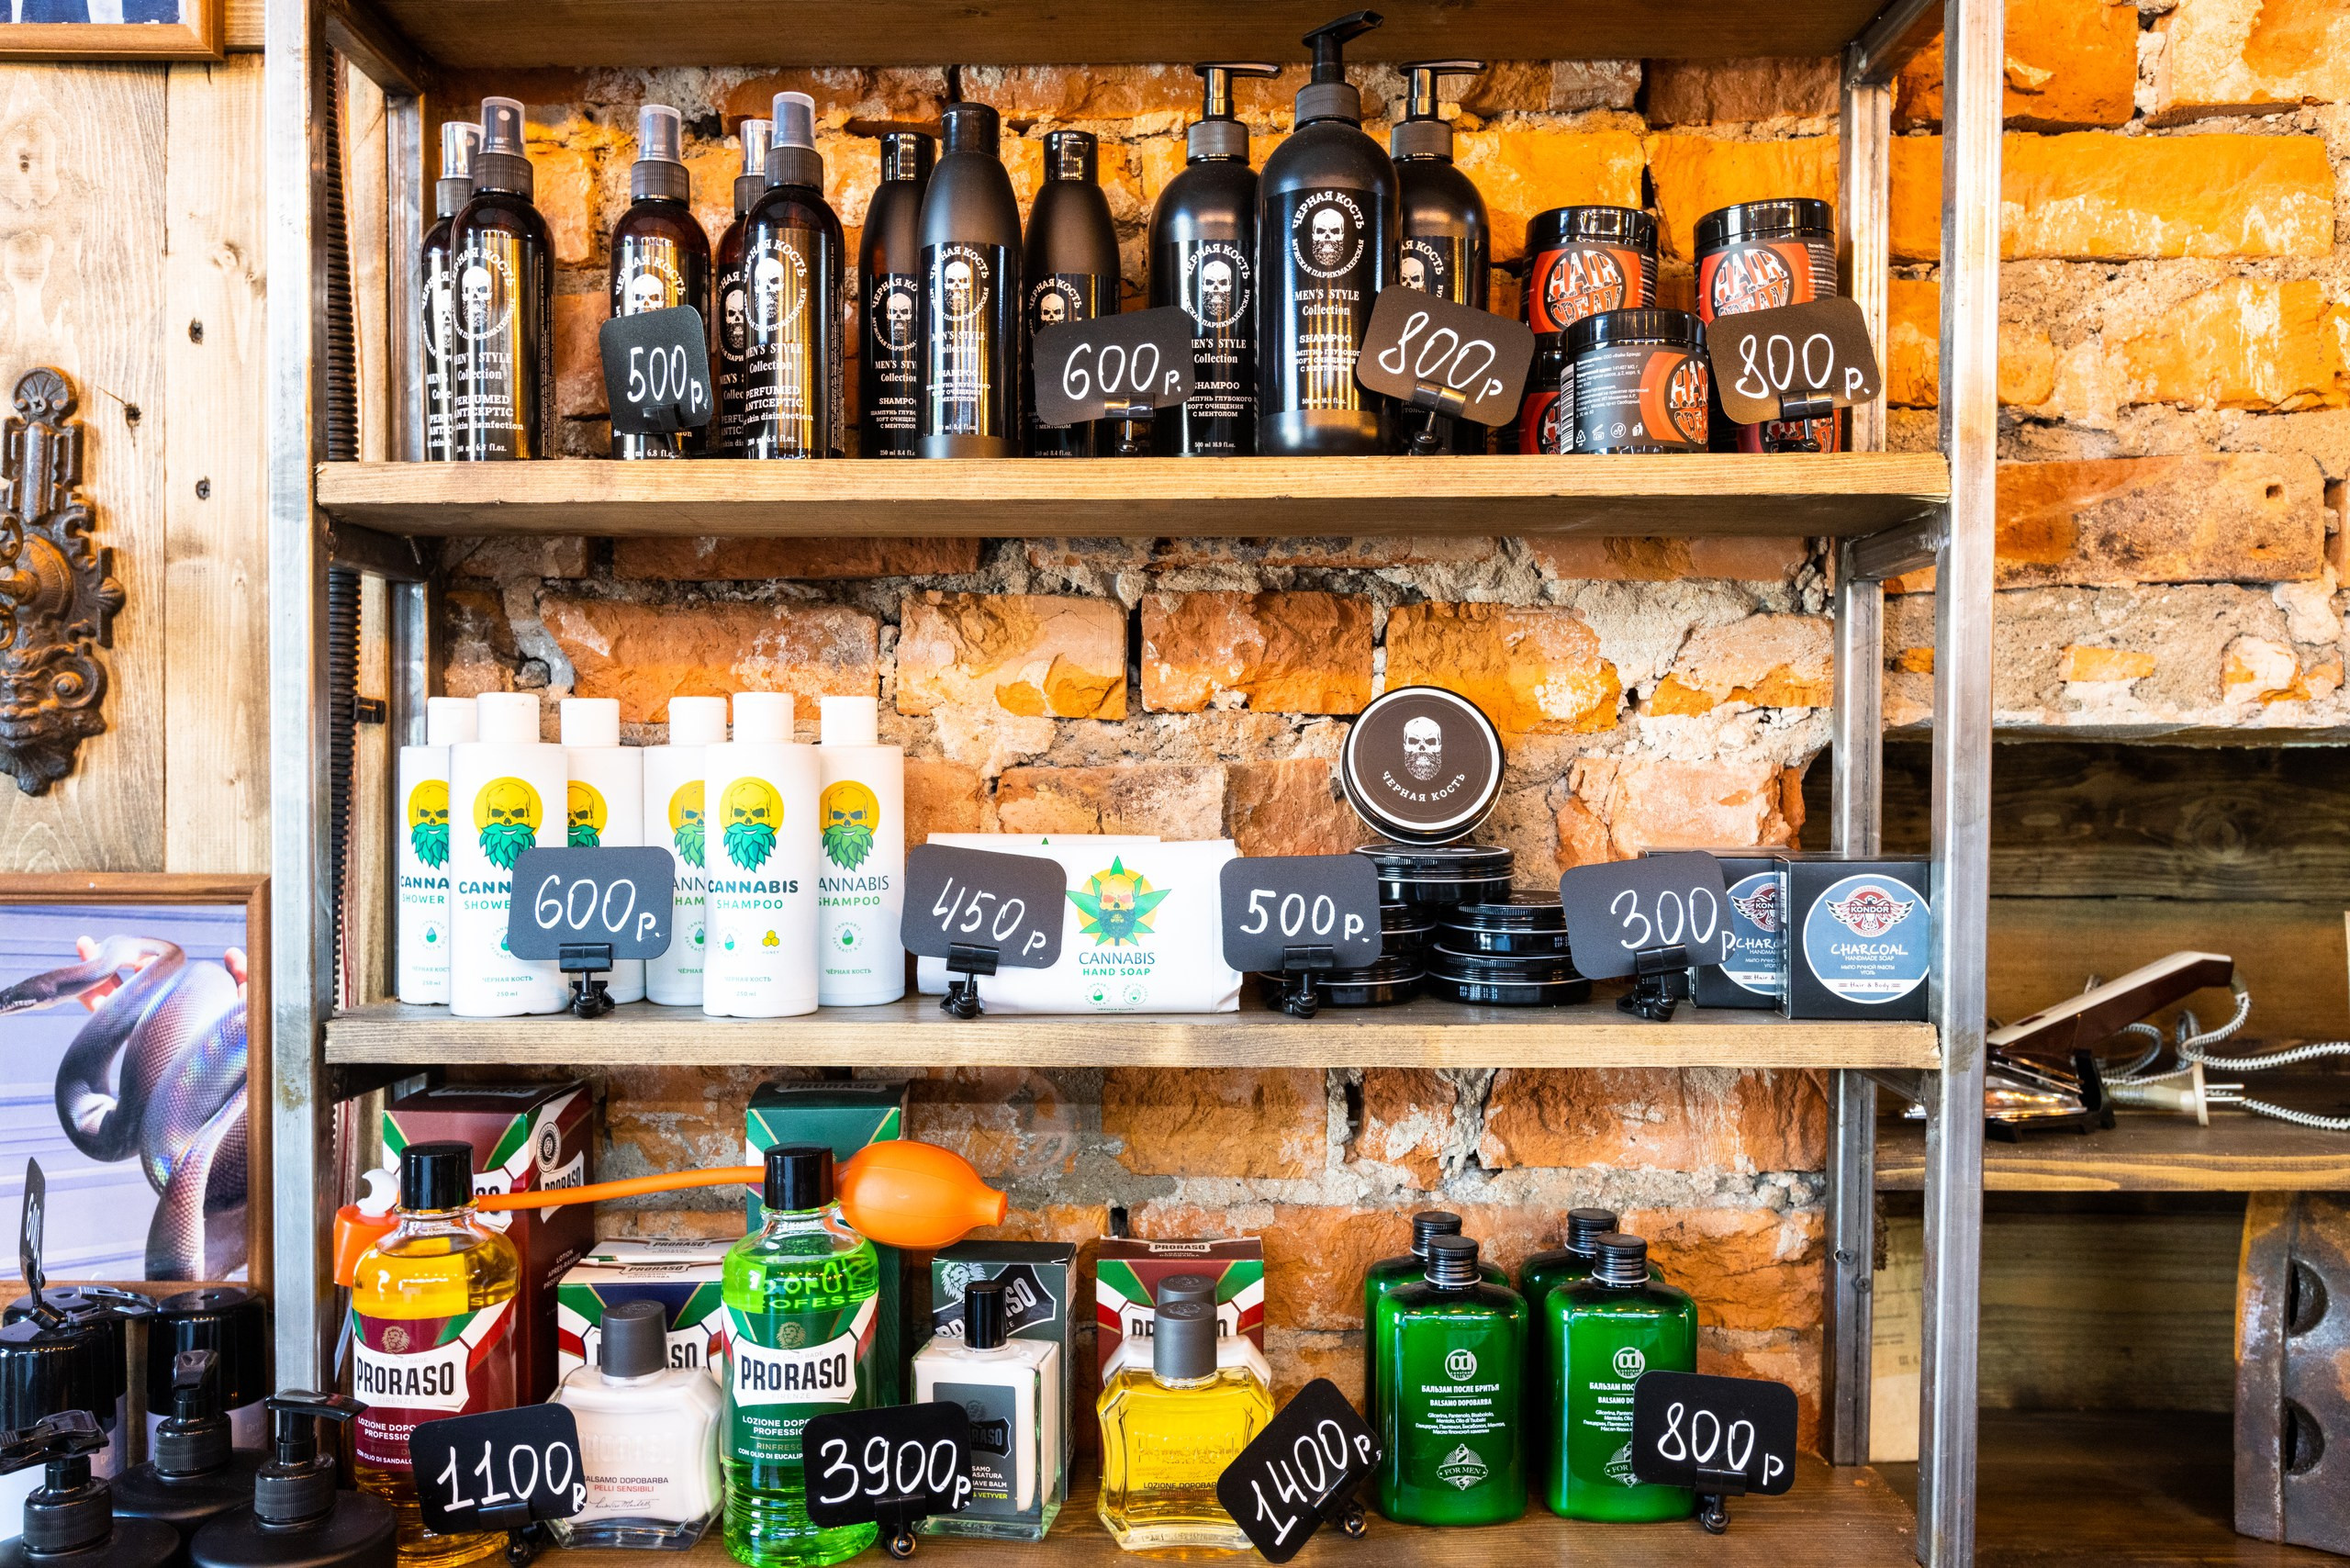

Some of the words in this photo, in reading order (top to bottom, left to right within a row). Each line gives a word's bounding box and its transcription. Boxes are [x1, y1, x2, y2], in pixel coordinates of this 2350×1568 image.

[1292, 191, 1334, 230] ЧЕРНАЯ
[1335, 192, 1365, 230] КОСТЬ
[774, 239, 808, 277] КОСТЬ
[963, 247, 990, 279] КОСТЬ
[1187, 243, 1221, 276] ЕРНАЯ
[1223, 244, 1251, 279] КОСТЬ
[1311, 239, 1365, 278] ПАРИКМАХЕРСКАЯ
[1416, 241, 1444, 275] КОСТЬ
[480, 248, 516, 287] КОСТЬ
[654, 257, 687, 296] КОСТЬ
[1547, 250, 1622, 303] HAIR
[1714, 248, 1789, 308] HAIR
[872, 277, 902, 308] ЧЕРНАЯ
[1028, 278, 1055, 310] ЧЕРНАЯ
[1056, 279, 1082, 308] КОСТЬ
[1329, 288, 1360, 301] STYLE
[1302, 304, 1350, 316] Collection
[1218, 338, 1247, 349] STYLE
[1299, 333, 1352, 343] SHAMPOO
[770, 342, 803, 354] STYLE
[478, 352, 513, 364] STYLE
[875, 359, 897, 370] MEN'S
[1194, 353, 1238, 364] Collection
[749, 360, 792, 374] Collection
[458, 368, 502, 381] Colection
[745, 386, 800, 400] PERFUMED
[454, 395, 509, 406] PERUMED
[744, 398, 804, 412] ANTICEPTIC
[760, 411, 813, 421] disinfection
[472, 420, 524, 431] isinfection
[1382, 770, 1427, 802] ЧЕРНАЯ
[1431, 771, 1466, 801] КОСТЬ
[401, 875, 449, 890] CANNA
[459, 880, 511, 894] CANN
[708, 879, 799, 894] CANNABIS
[402, 894, 445, 904] SHOWER
[717, 899, 783, 909] SHAMPOO
[534, 874, 661, 943] 600р.
[1239, 889, 1371, 943] 500р.
[1610, 887, 1737, 961] 300р.
[1830, 943, 1908, 956] CHARCOAL
[1079, 952, 1156, 965] CANNABIS
[1082, 968, 1115, 976] HAND
[1120, 968, 1151, 976] SOAP
[1874, 981, 1889, 991] Body
[555, 1249, 575, 1264] LOTION
[356, 1354, 454, 1396] PRORASO
[741, 1352, 847, 1391] PRORASO
[1421, 1384, 1452, 1393] БАЛЬЗАМ
[1454, 1384, 1473, 1393] ПОСЛЕ
[1475, 1383, 1500, 1392] БРИТЬЯ
[1589, 1382, 1621, 1391] БАЛЬЗАМ
[1458, 1398, 1493, 1406] DOPOBARBA
[358, 1416, 386, 1431] LOZIONE
[742, 1415, 780, 1428] LOZIONE
[738, 1447, 749, 1456] CON
[750, 1450, 765, 1459] OLIO
[594, 1484, 614, 1492] PELLI
